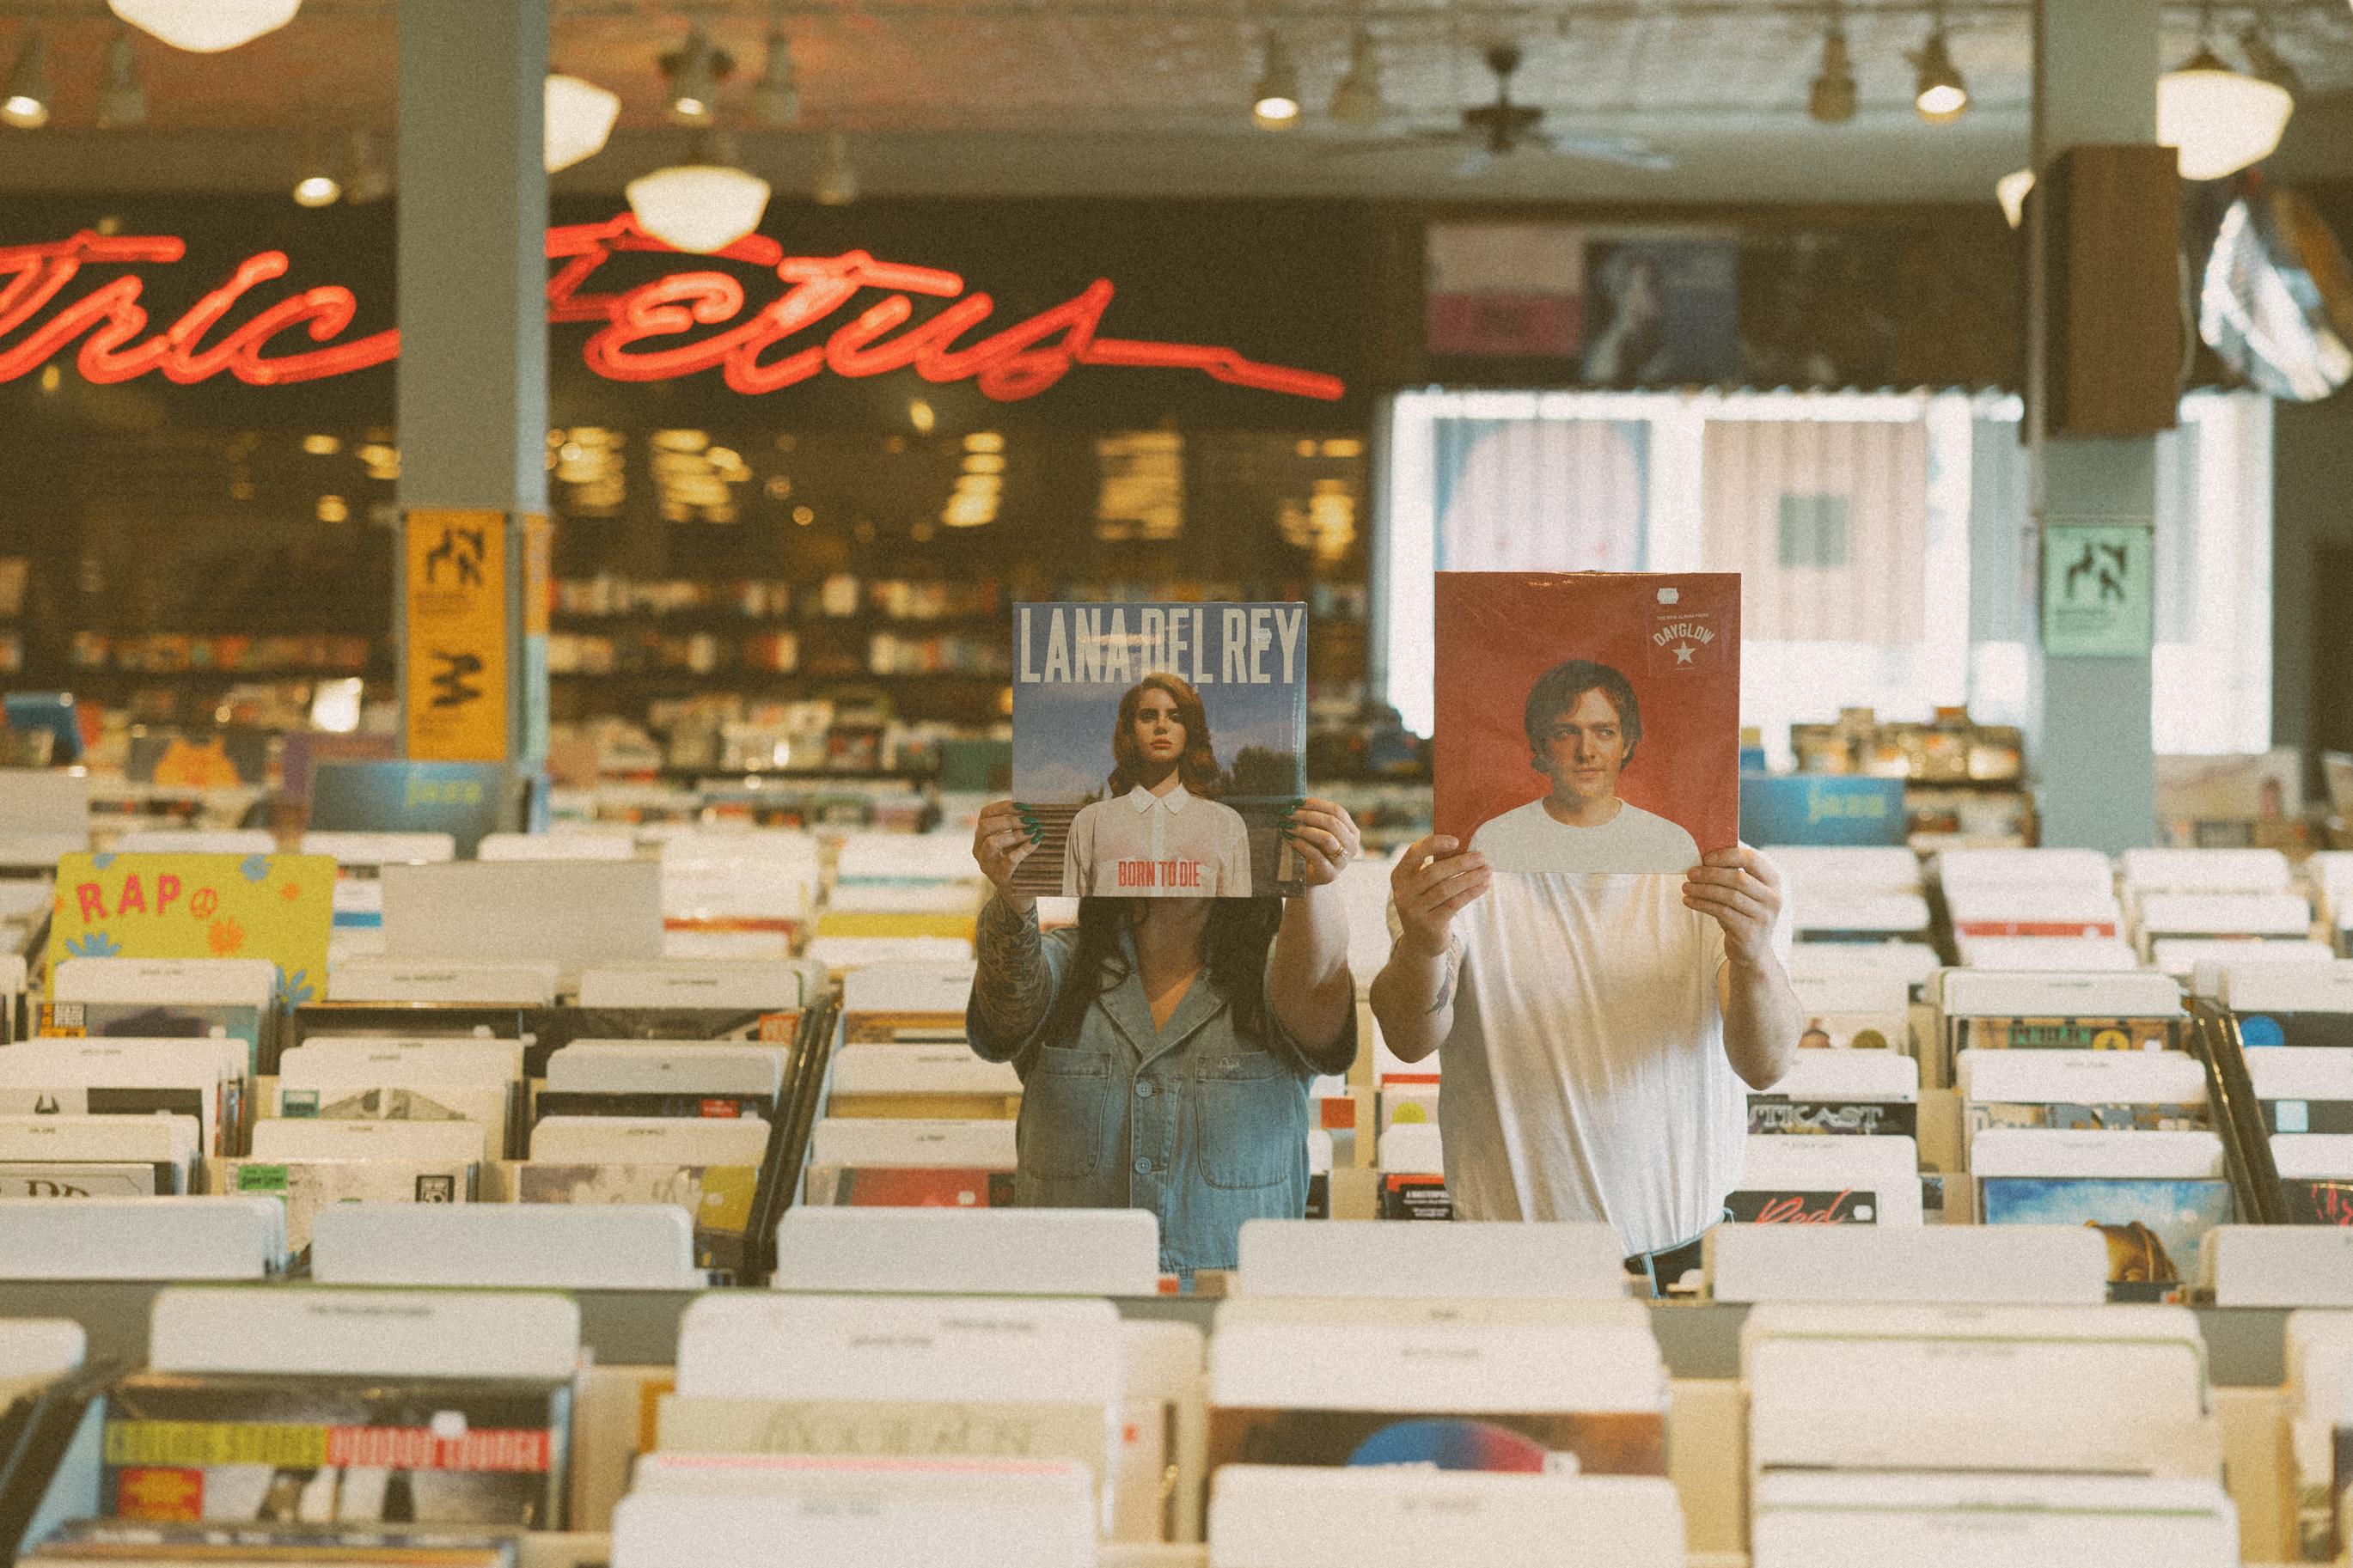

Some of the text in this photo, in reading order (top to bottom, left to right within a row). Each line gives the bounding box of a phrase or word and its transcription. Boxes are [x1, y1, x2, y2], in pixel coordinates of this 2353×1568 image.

[1020, 607, 1303, 684] LANA DEL REY
[1653, 622, 1715, 647] DAYGLOW
[1118, 861, 1201, 888] BORN TO DIE
[76, 873, 181, 924] RAP
